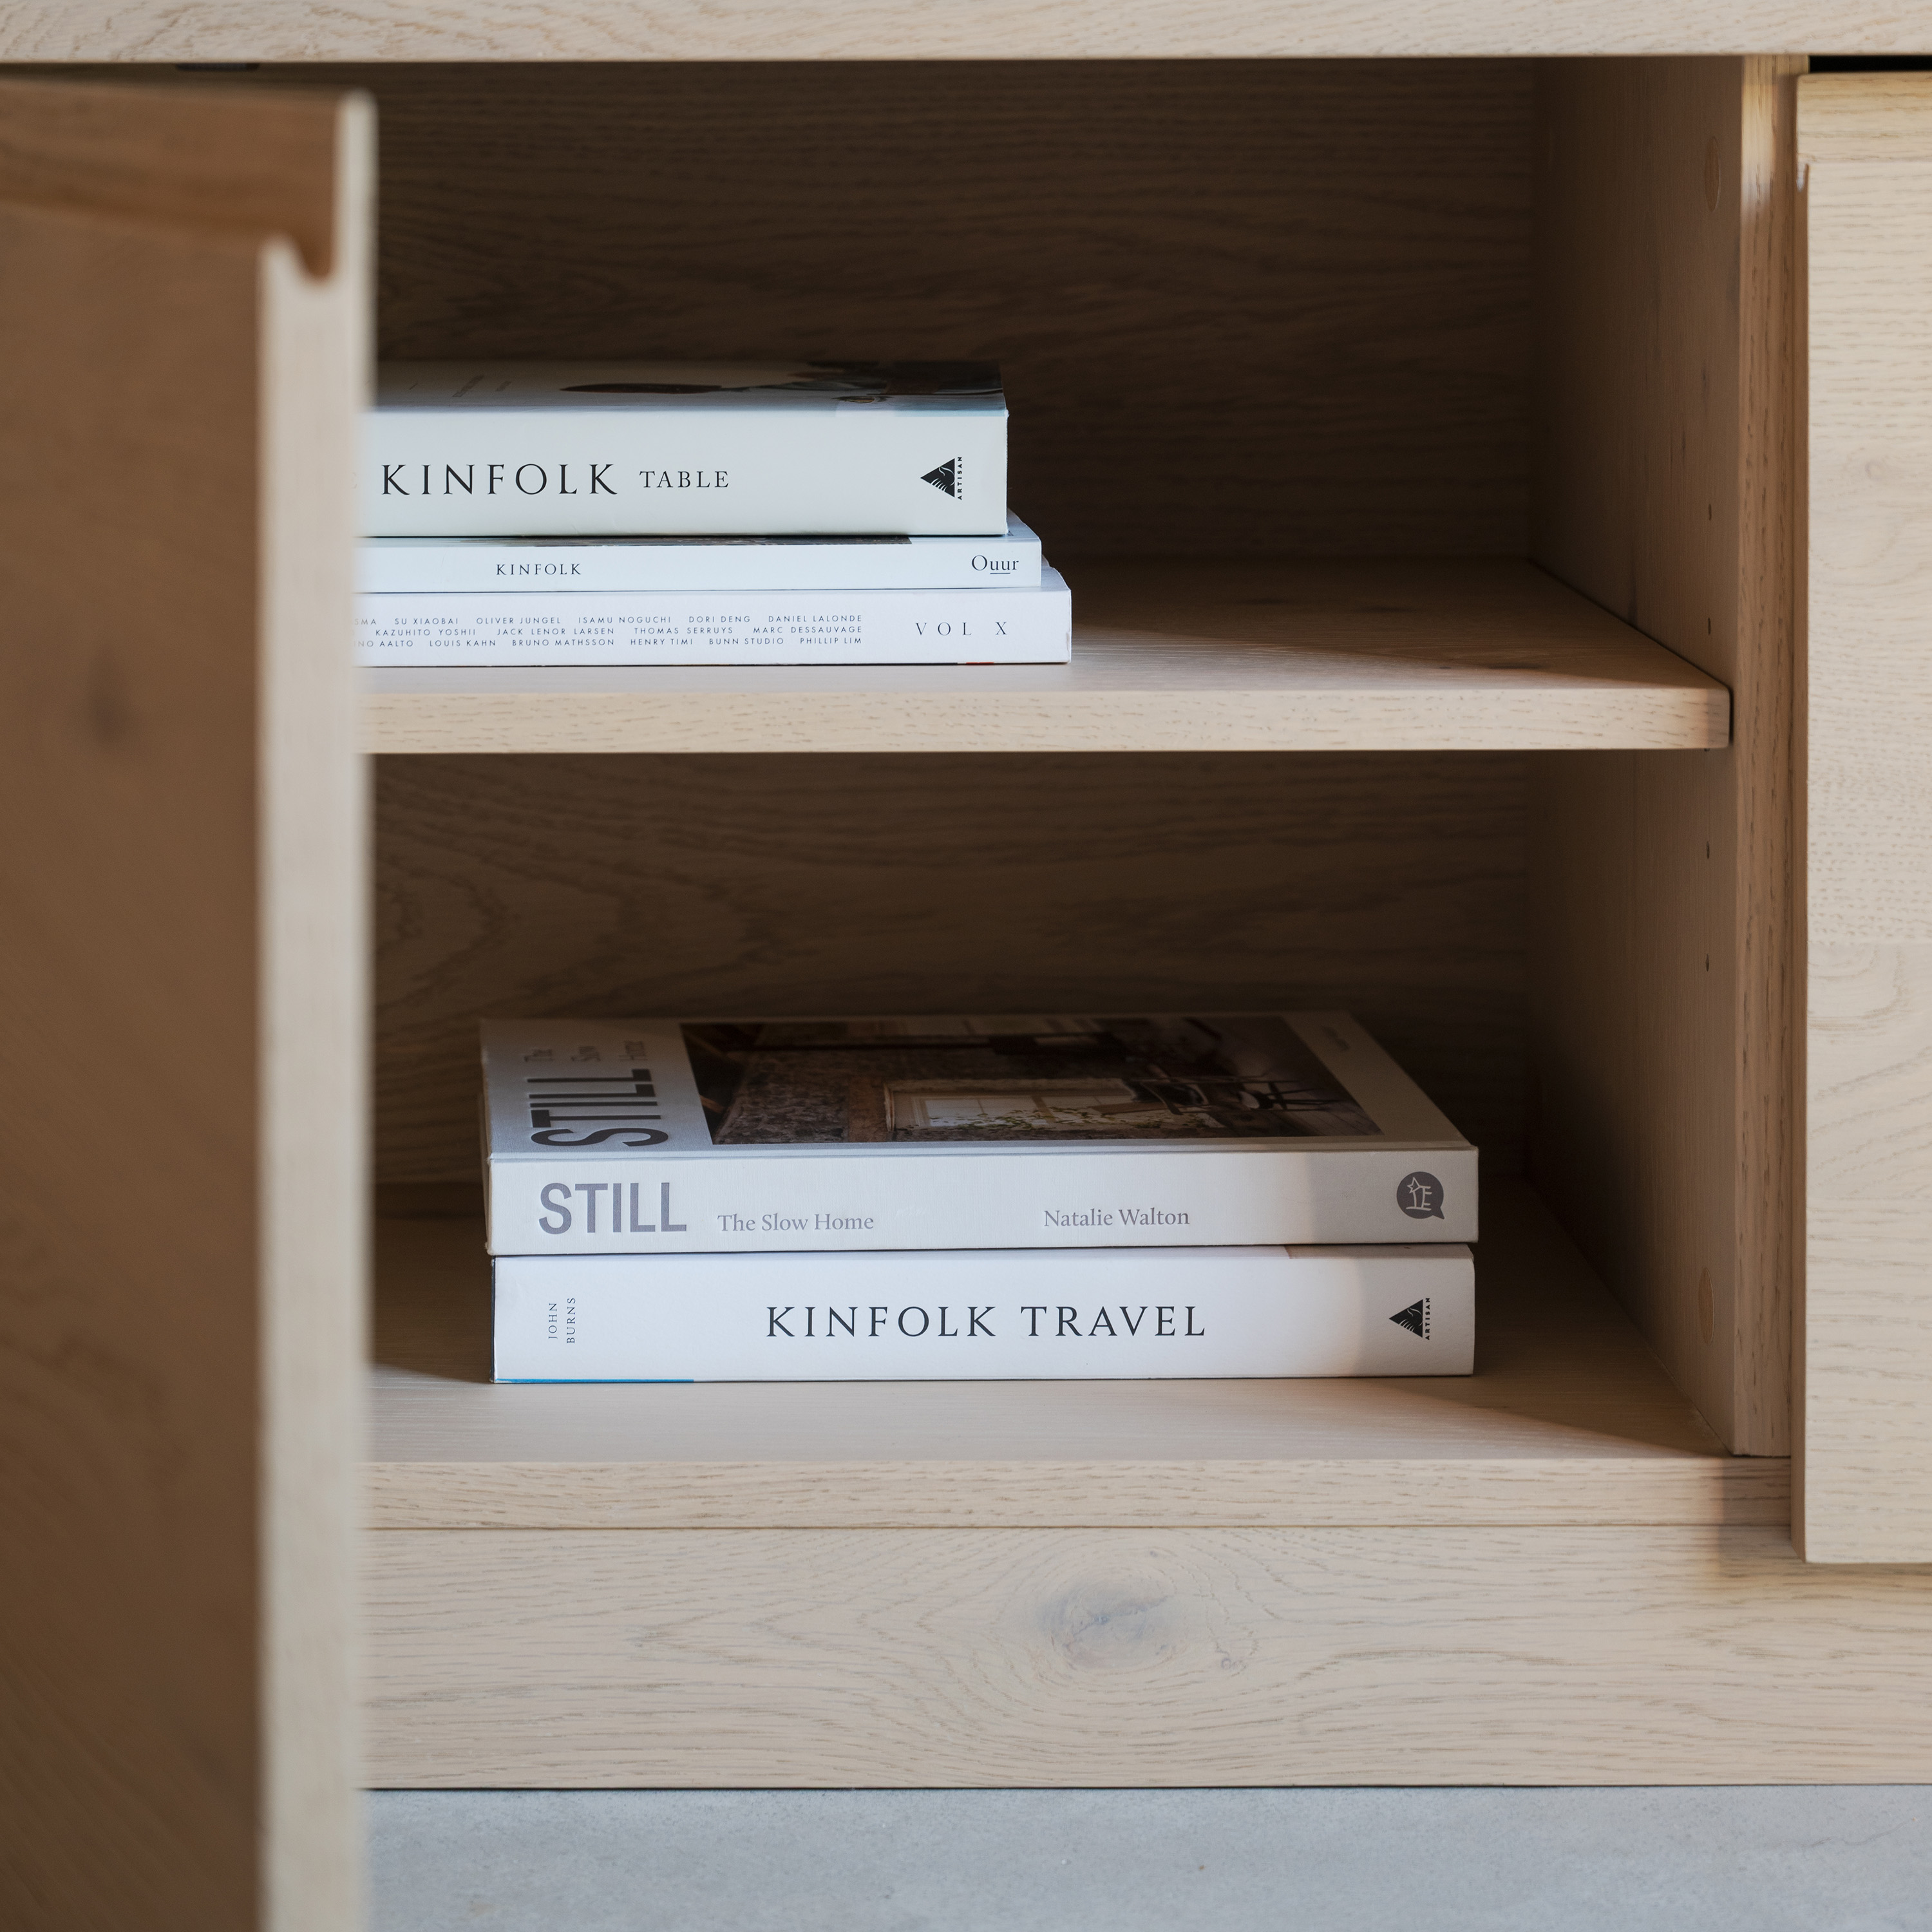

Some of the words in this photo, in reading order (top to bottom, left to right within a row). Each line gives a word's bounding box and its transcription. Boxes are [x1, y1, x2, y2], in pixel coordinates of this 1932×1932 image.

[382, 464, 617, 495] KINFOLK
[639, 471, 728, 488] TABLE
[497, 564, 581, 575] KINFOLK
[972, 555, 1019, 574] Ouur
[916, 622, 971, 636] VOL
[996, 622, 1007, 635] X
[353, 639, 374, 648] INO
[526, 1068, 668, 1147] STILL
[538, 1182, 687, 1235] STILL
[1044, 1208, 1113, 1226] Natalie
[1119, 1207, 1190, 1225] Walton
[717, 1213, 755, 1231] The
[762, 1213, 808, 1231] Slow
[815, 1213, 874, 1230] Home
[549, 1303, 558, 1339] JOHN
[567, 1298, 576, 1343] BURNS
[766, 1307, 996, 1337] KINFOLK
[1021, 1306, 1204, 1336] TRAVEL
